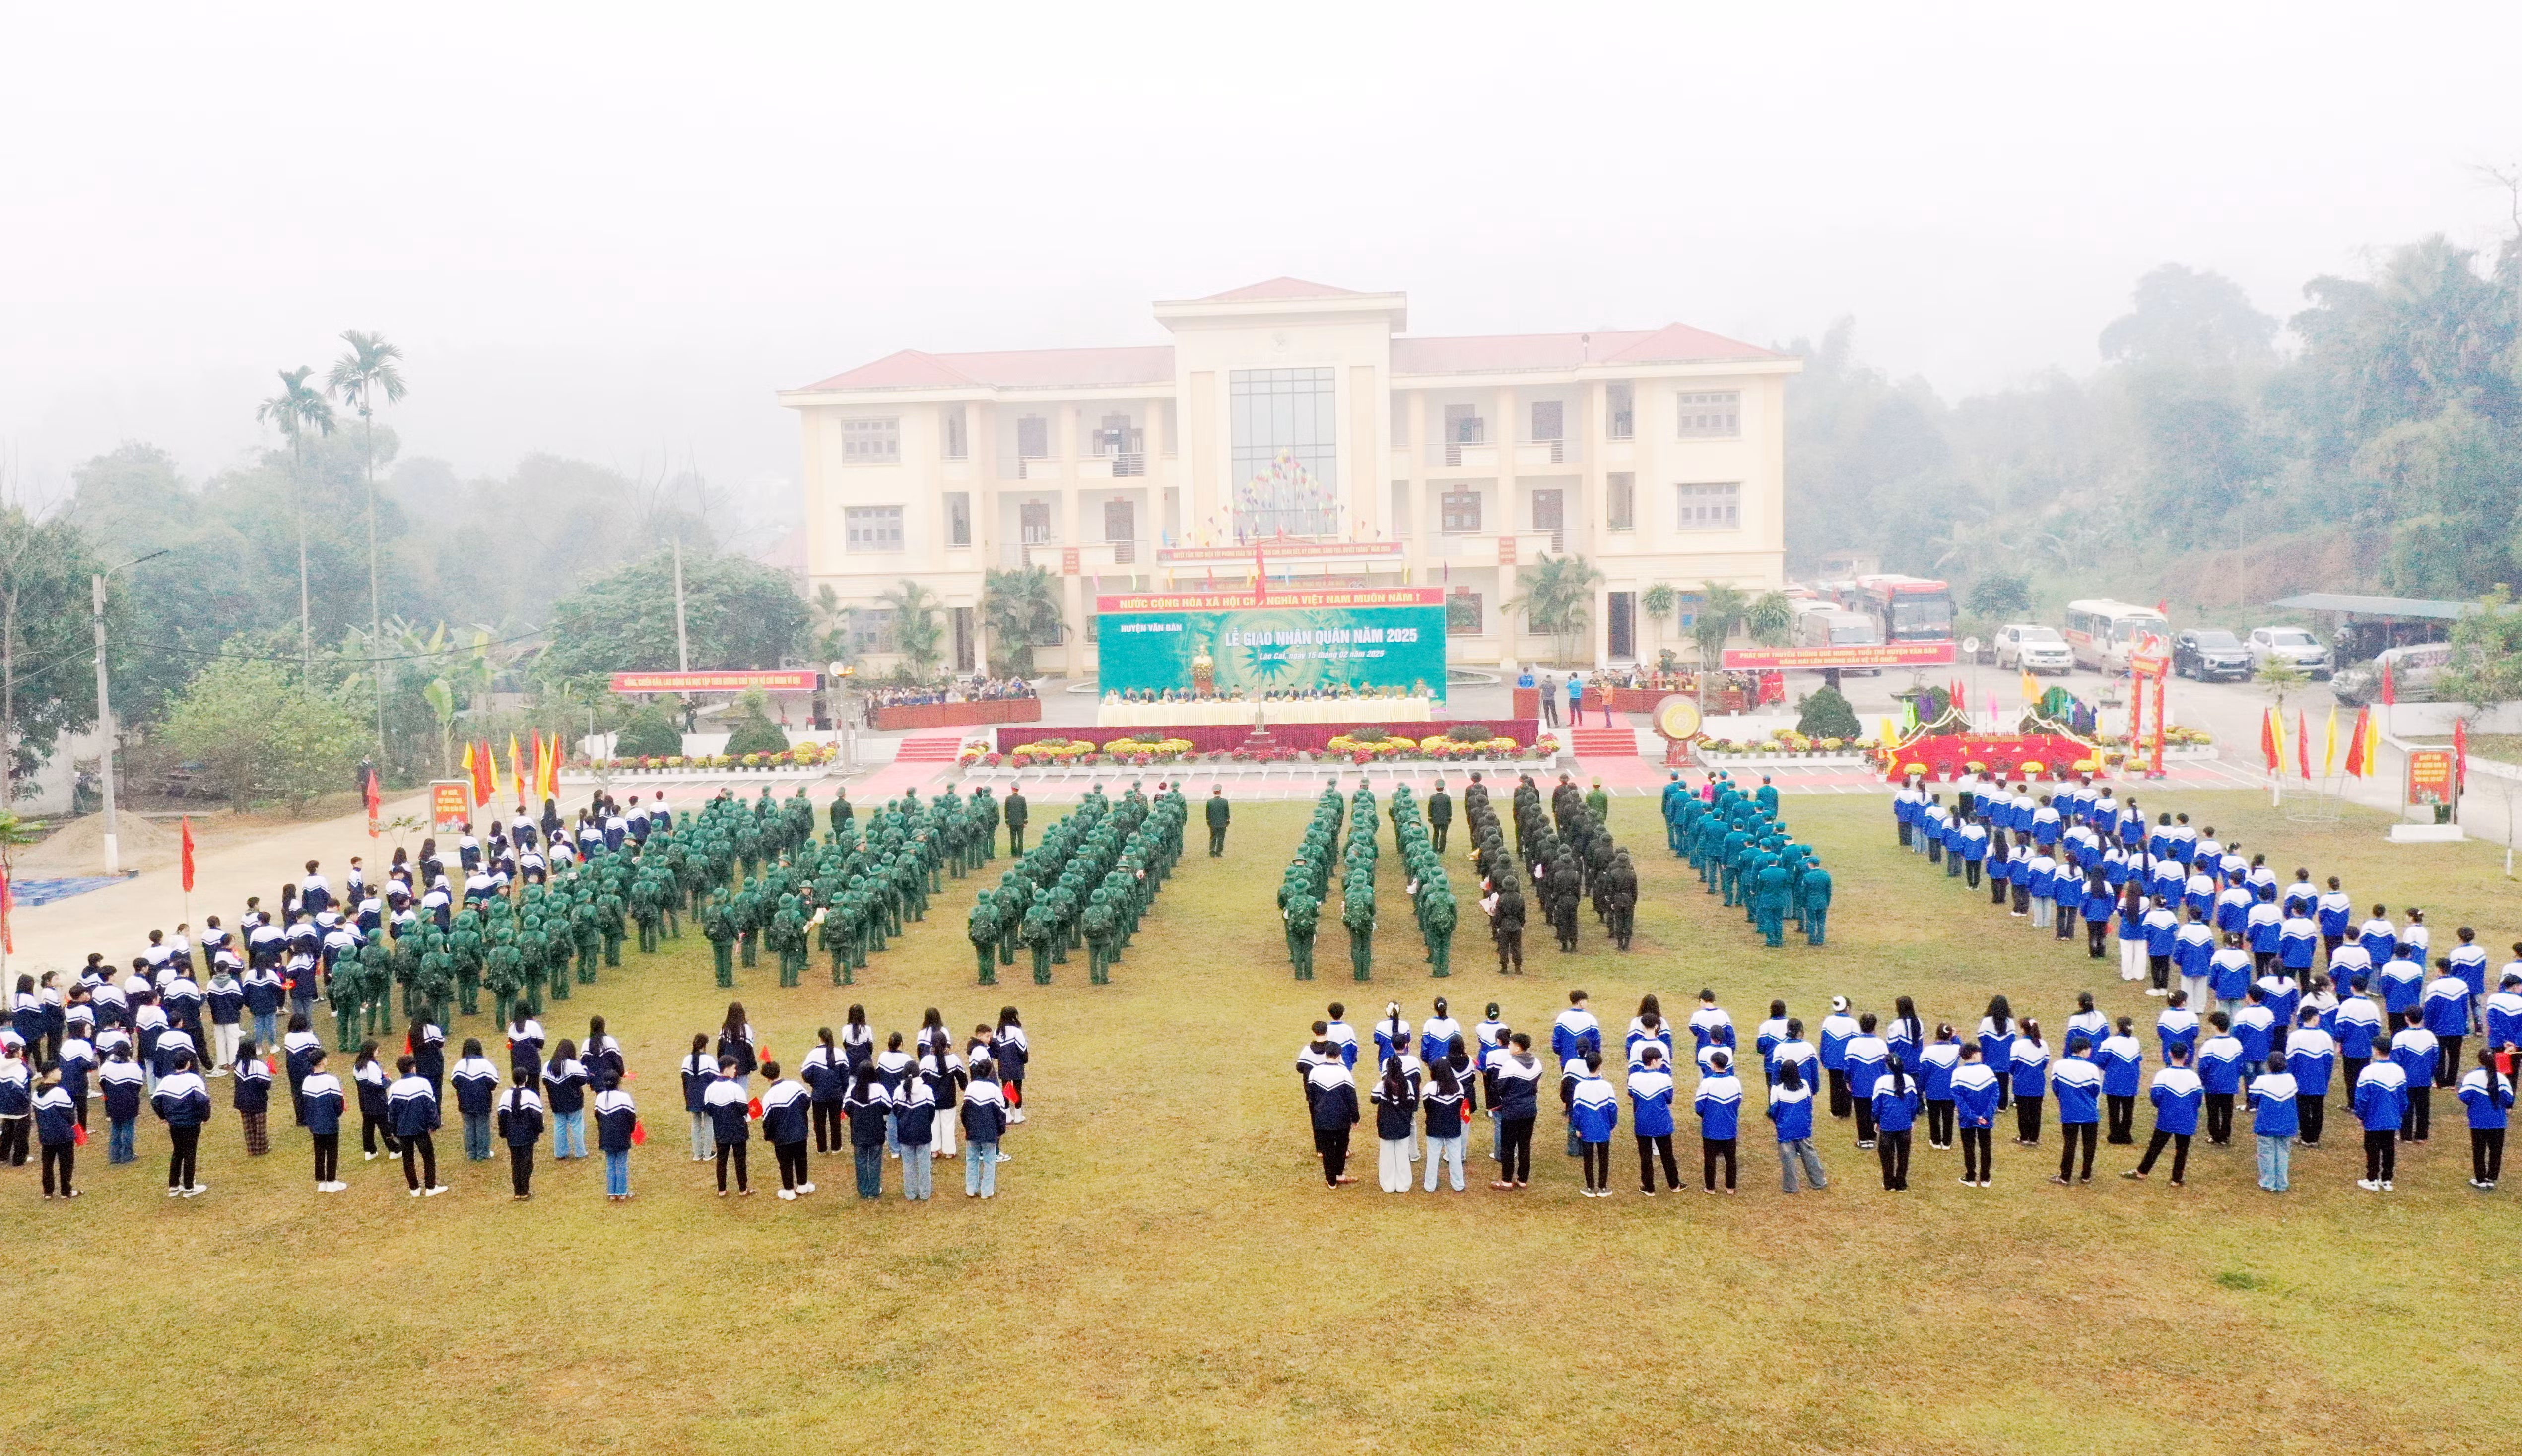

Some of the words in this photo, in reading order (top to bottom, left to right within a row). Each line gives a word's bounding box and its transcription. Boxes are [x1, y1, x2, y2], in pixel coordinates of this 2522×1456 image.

[1120, 597, 1148, 609] NƯỚC
[1151, 597, 1179, 609] CỘNG
[1182, 596, 1203, 607] HÒA
[1206, 596, 1220, 607] XÃ
[1222, 596, 1240, 608] HỘI
[1266, 595, 1299, 605] NGHĨA
[1301, 594, 1324, 606] VIỆT
[1327, 595, 1351, 604] NAM
[1354, 593, 1385, 603] MUÔN
[1388, 592, 1413, 602] NĂM
[1121, 623, 1146, 634] HUYỆN
[1148, 623, 1164, 632] VĂN
[1166, 623, 1182, 632] BÀN
[1225, 627, 1239, 646] LỄ
[1243, 632, 1272, 646] GIAO
[1276, 628, 1311, 648] NHẬN
[1315, 628, 1350, 645] QUÂN
[1353, 627, 1383, 644] NĂM
[1387, 628, 1417, 643] 2025
